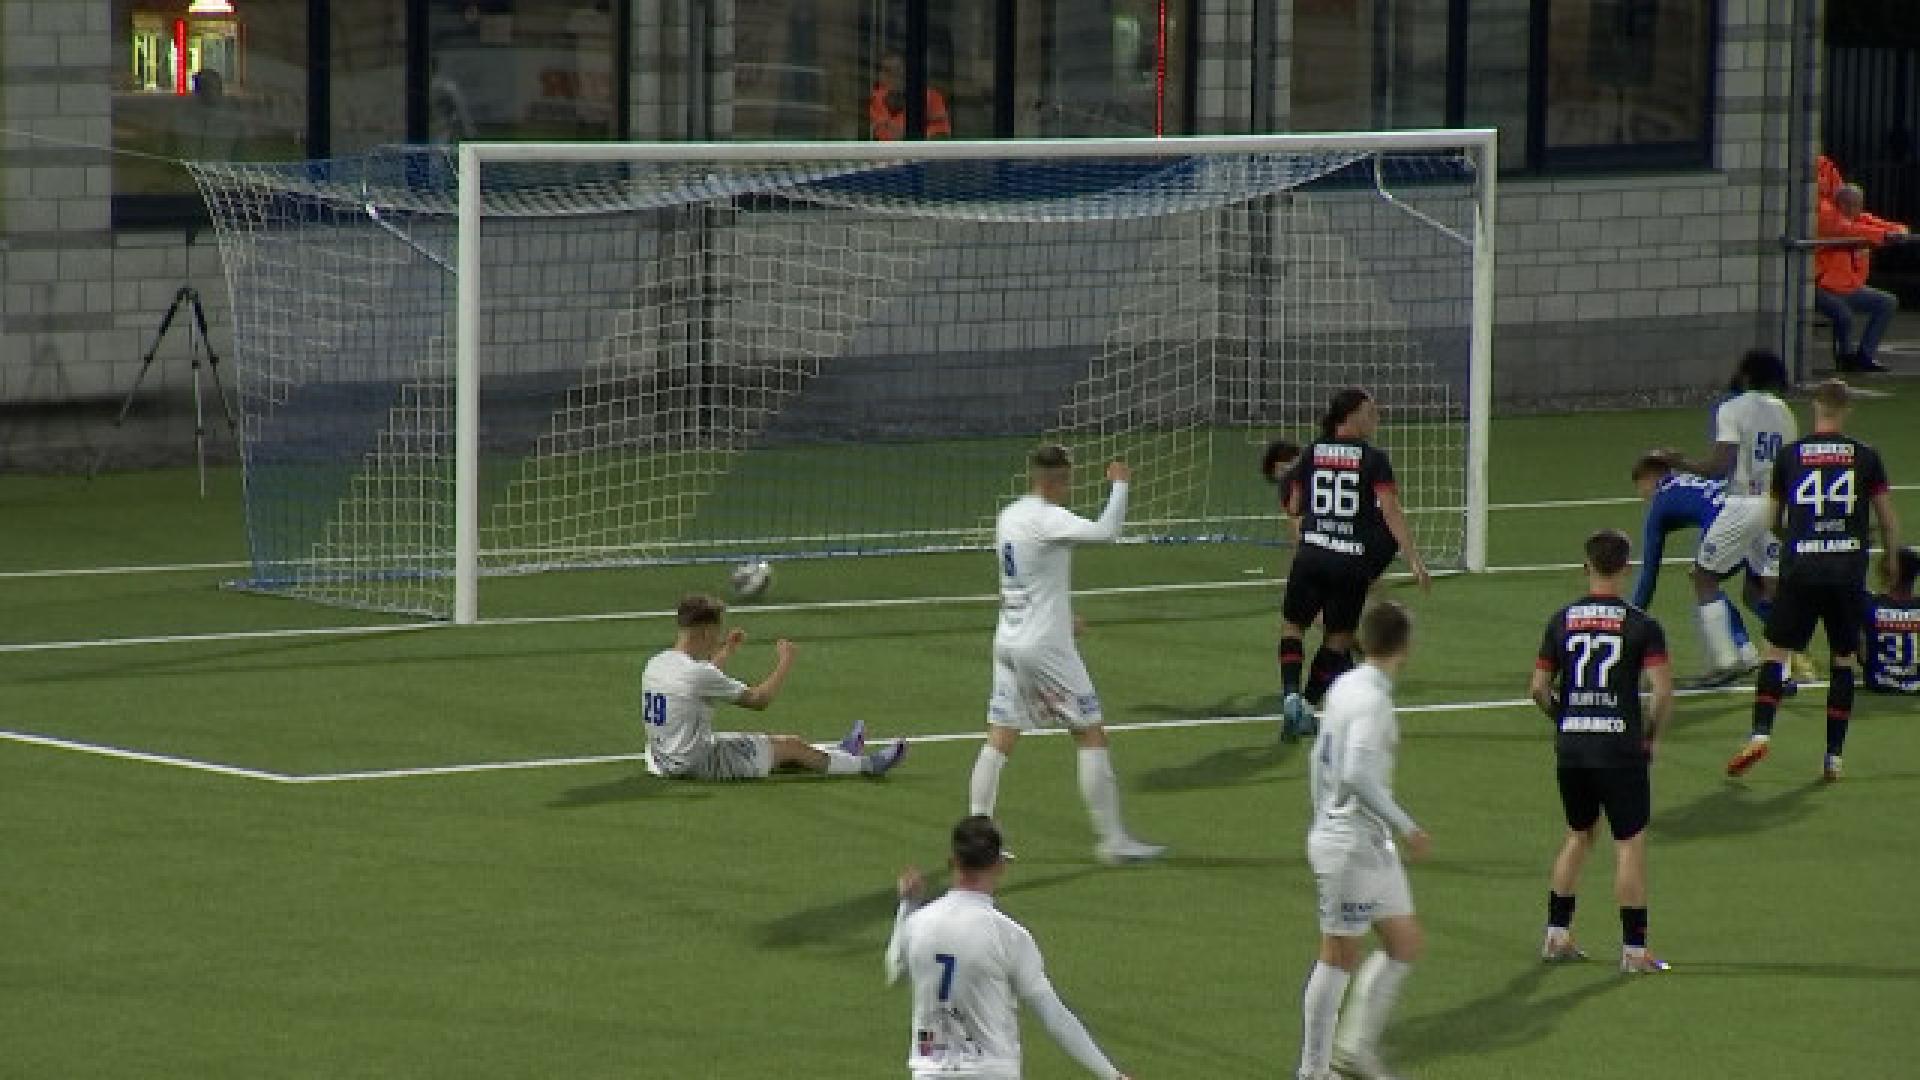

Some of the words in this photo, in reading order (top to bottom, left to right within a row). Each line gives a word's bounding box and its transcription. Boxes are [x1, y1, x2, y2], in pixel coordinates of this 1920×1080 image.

[1755, 431, 1783, 462] 50
[1311, 470, 1360, 516] 66
[1796, 468, 1857, 516] 44
[1566, 632, 1623, 688] 77
[644, 690, 667, 727] 29
[935, 953, 957, 1002] 7
